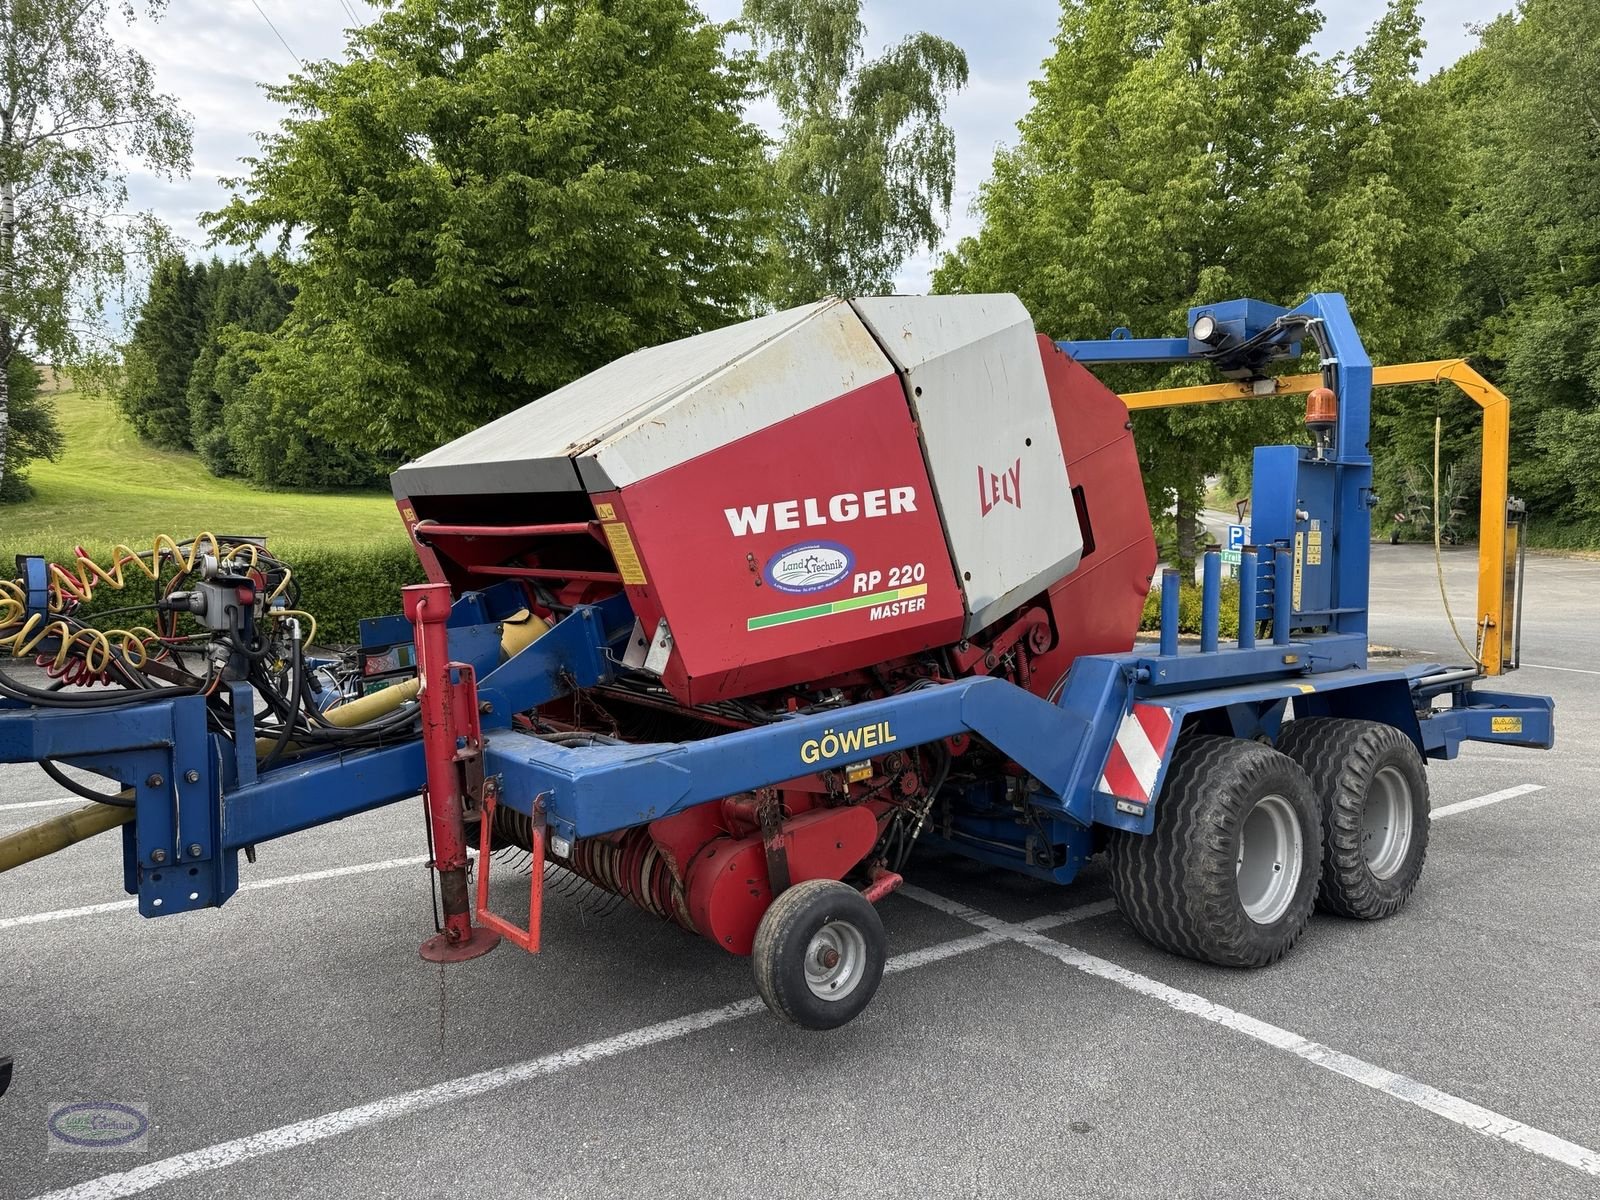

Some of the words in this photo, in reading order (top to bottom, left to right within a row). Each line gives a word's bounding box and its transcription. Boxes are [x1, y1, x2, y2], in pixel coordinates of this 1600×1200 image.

[977, 457, 1021, 518] LELY
[724, 486, 917, 537] WELGER
[1231, 527, 1242, 544] P
[782, 559, 804, 572] Land
[812, 559, 843, 573] Technik
[853, 571, 882, 594] RP
[888, 563, 925, 587] 220
[870, 597, 926, 621] MASTER
[801, 721, 897, 764] GÖWEIL
